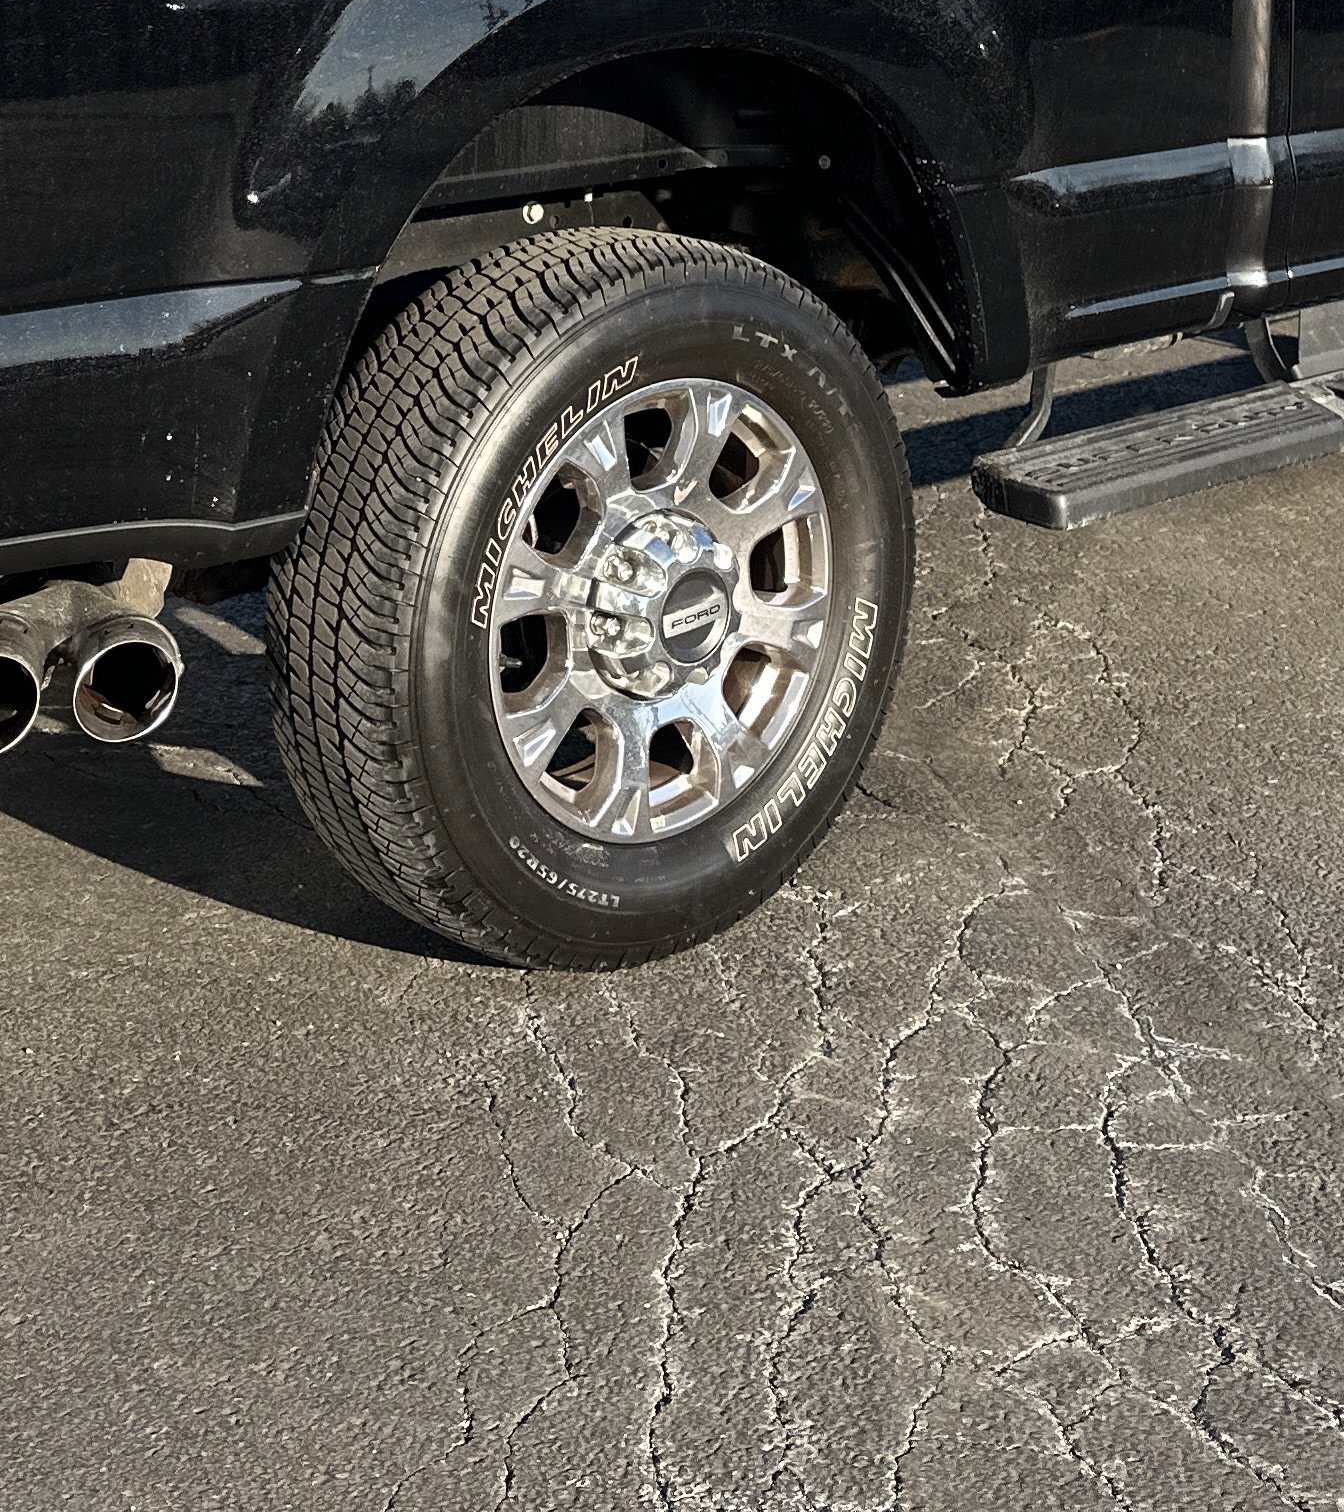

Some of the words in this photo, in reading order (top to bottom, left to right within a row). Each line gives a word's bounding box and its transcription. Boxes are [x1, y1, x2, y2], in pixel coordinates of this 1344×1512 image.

[731, 324, 799, 362] LTX
[470, 355, 640, 629] MICHELIN
[671, 603, 721, 630] FORD
[732, 597, 879, 862] MICHELIN
[508, 834, 621, 908] LT275/65R20
